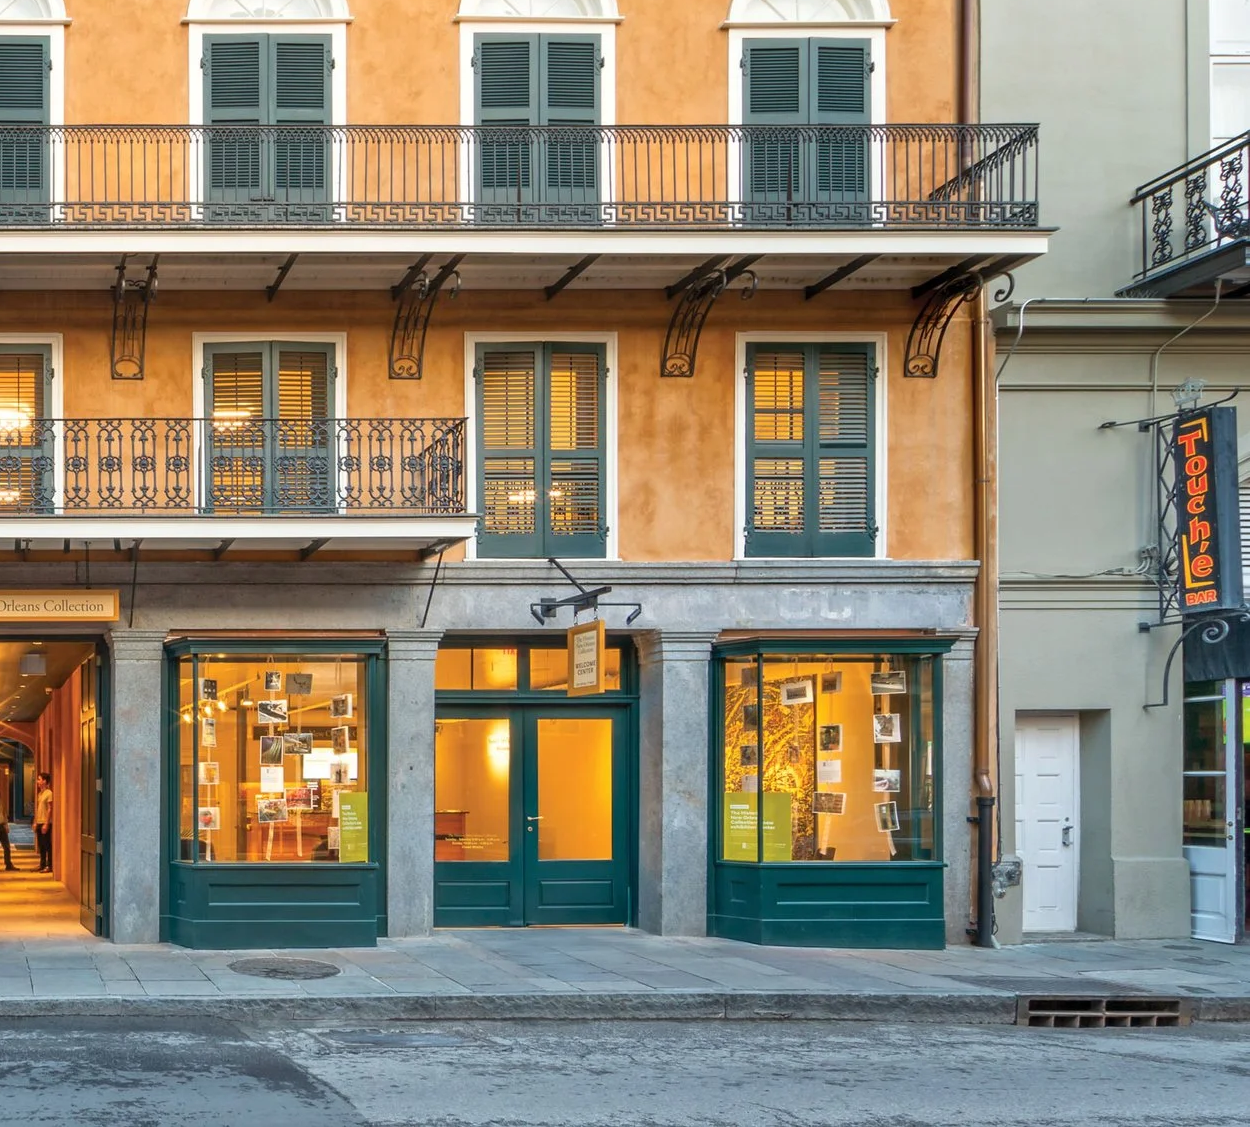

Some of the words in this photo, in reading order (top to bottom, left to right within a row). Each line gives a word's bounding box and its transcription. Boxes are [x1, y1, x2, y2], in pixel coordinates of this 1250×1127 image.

[1185, 589, 1217, 606] BAR
[43, 600, 104, 612] Collection
[576, 660, 596, 669] WELCOME
[577, 667, 594, 675] CENTER
